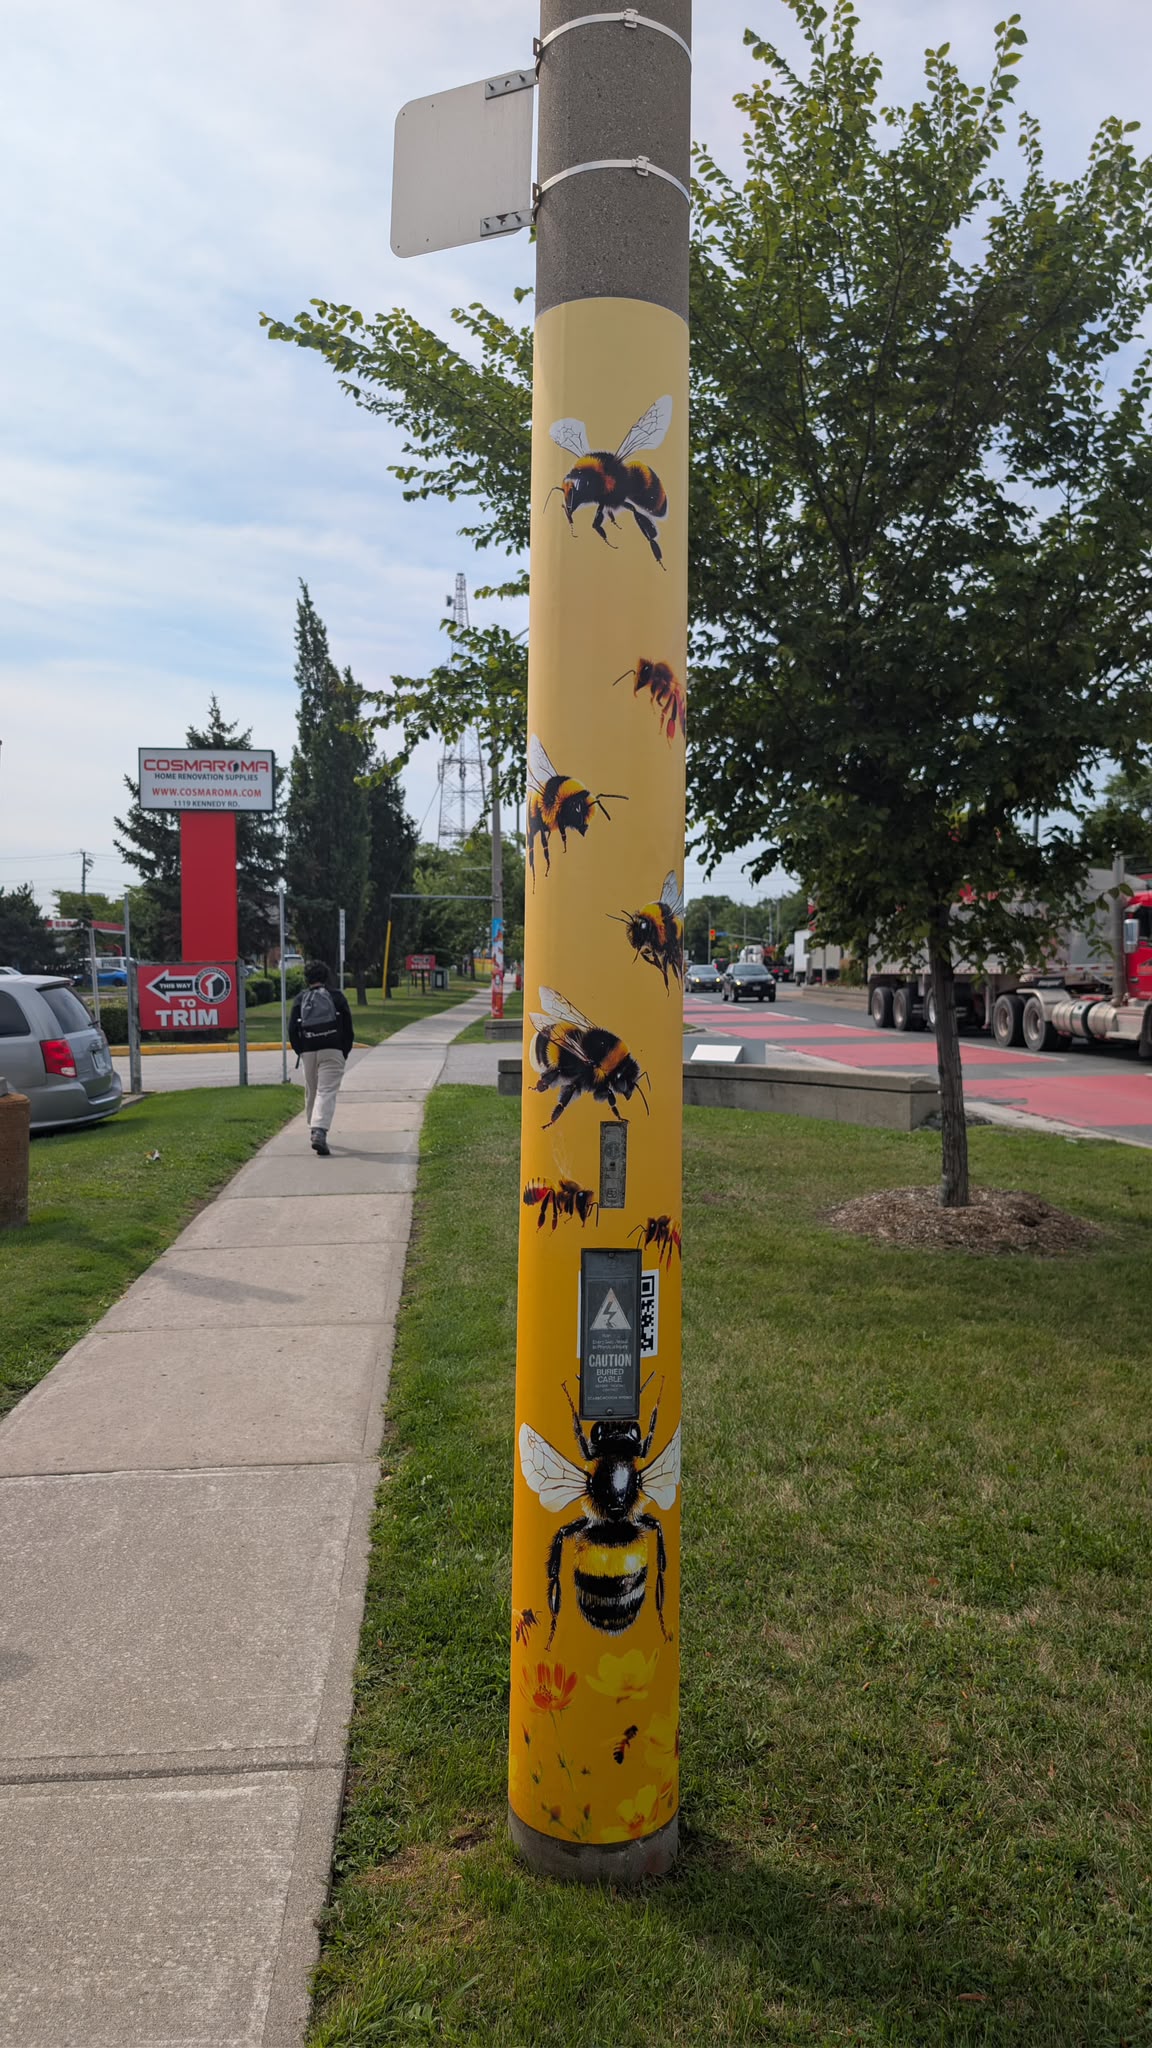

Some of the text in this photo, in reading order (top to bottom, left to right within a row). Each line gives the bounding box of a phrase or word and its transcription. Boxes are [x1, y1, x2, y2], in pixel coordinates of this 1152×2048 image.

[178, 773, 224, 781] RENOVATION
[152, 787, 262, 797] WWW.COSMAROMA.COM
[178, 999, 196, 1008] TO
[155, 1009, 218, 1027] TRIM
[588, 1353, 632, 1367] CAUTION
[596, 1368, 624, 1376] BURIED
[597, 1375, 623, 1383] CABLE
